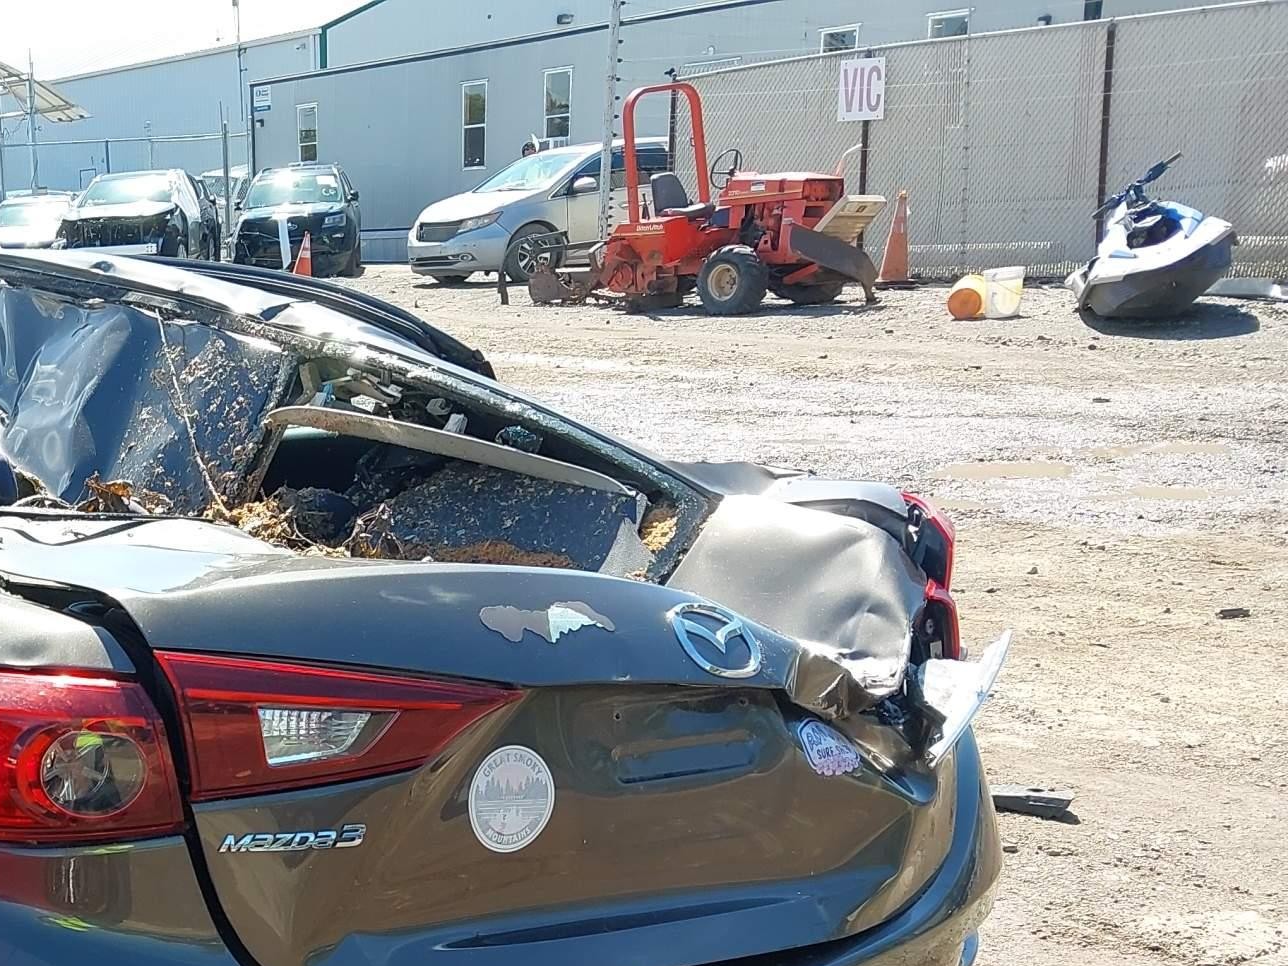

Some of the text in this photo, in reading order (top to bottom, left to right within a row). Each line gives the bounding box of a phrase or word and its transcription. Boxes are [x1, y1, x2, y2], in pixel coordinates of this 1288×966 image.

[843, 65, 882, 112] VIC
[816, 746, 834, 760] SURF
[482, 752, 543, 778] GREAT SMOKY
[486, 826, 531, 845] MOUNTAINS
